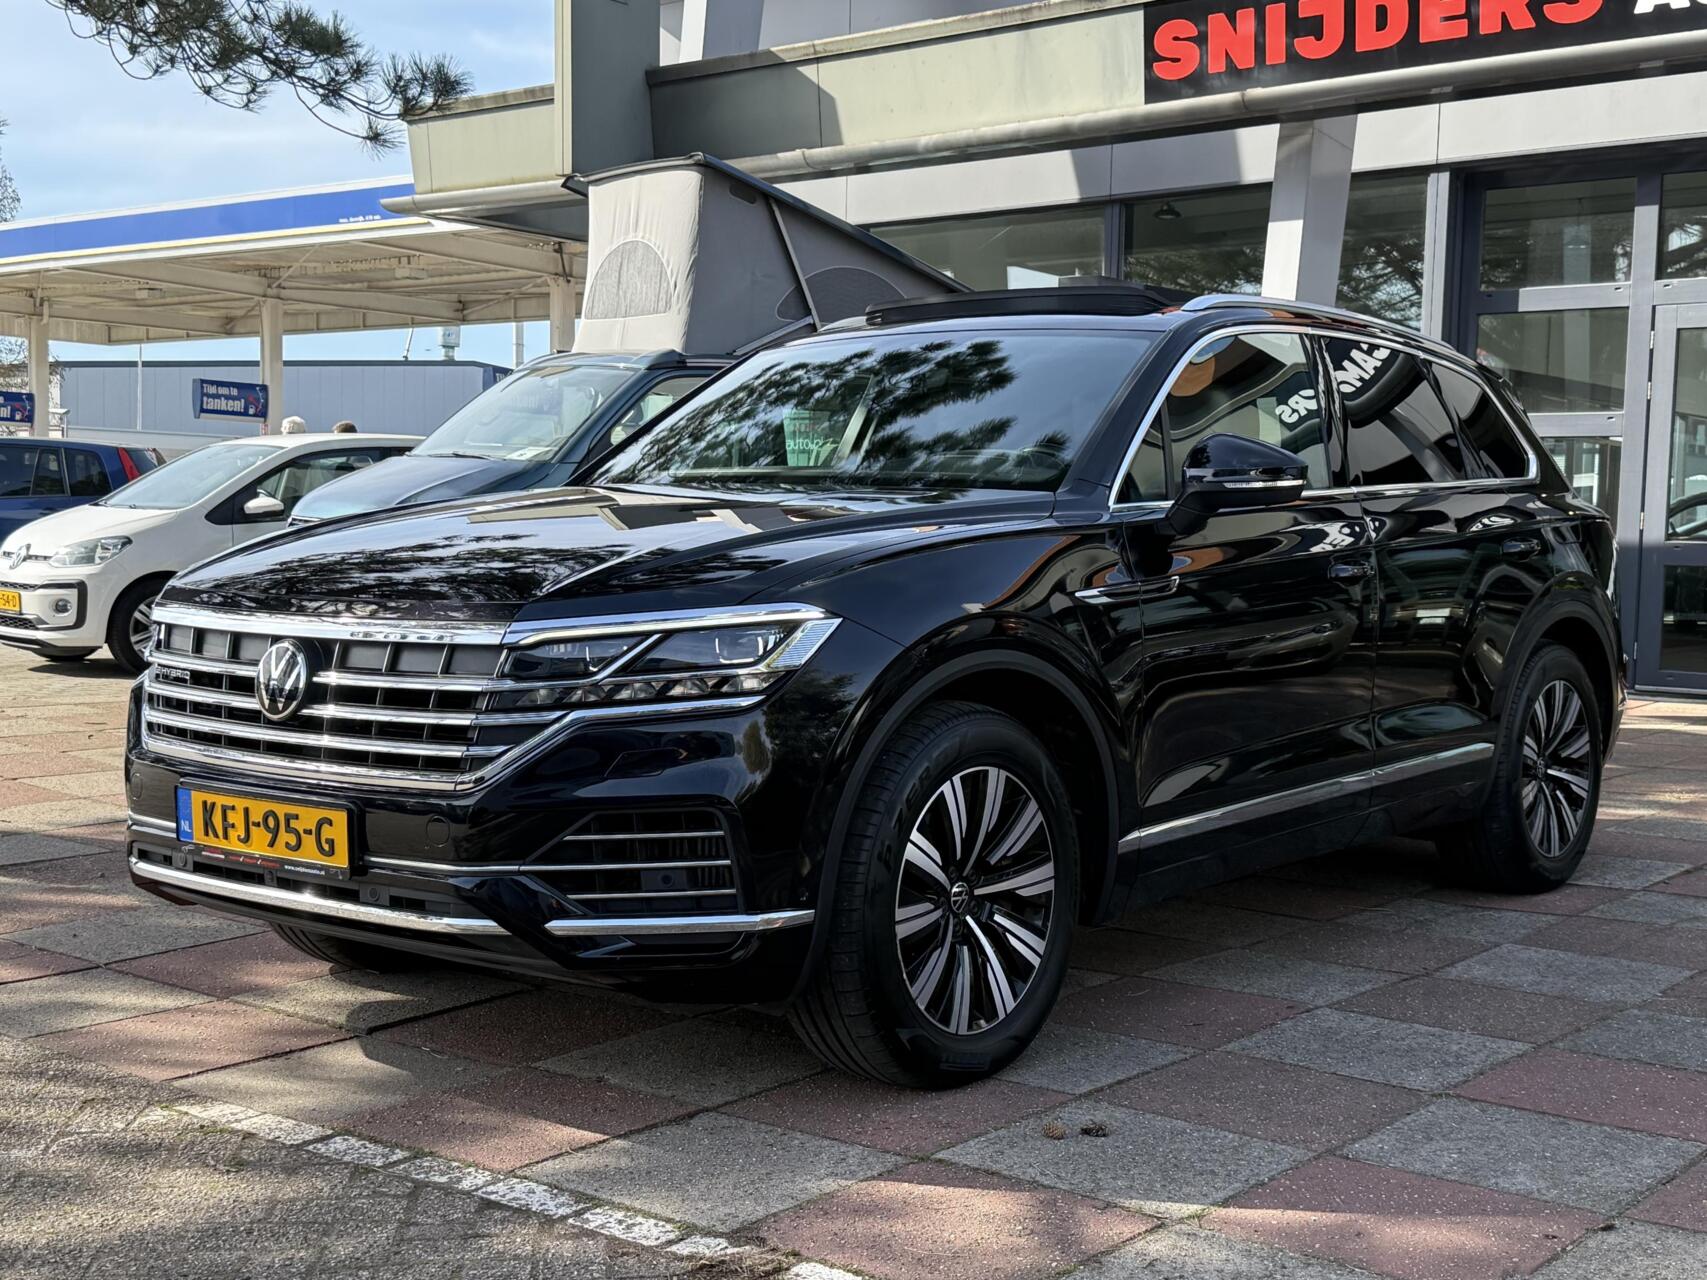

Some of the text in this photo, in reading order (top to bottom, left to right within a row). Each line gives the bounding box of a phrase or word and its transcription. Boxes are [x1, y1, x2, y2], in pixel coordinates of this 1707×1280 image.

[218, 386, 229, 395] om
[230, 387, 238, 396] te
[202, 396, 245, 412] tanken!
[181, 820, 192, 833] NL
[201, 800, 336, 857] KFJ-95-G
